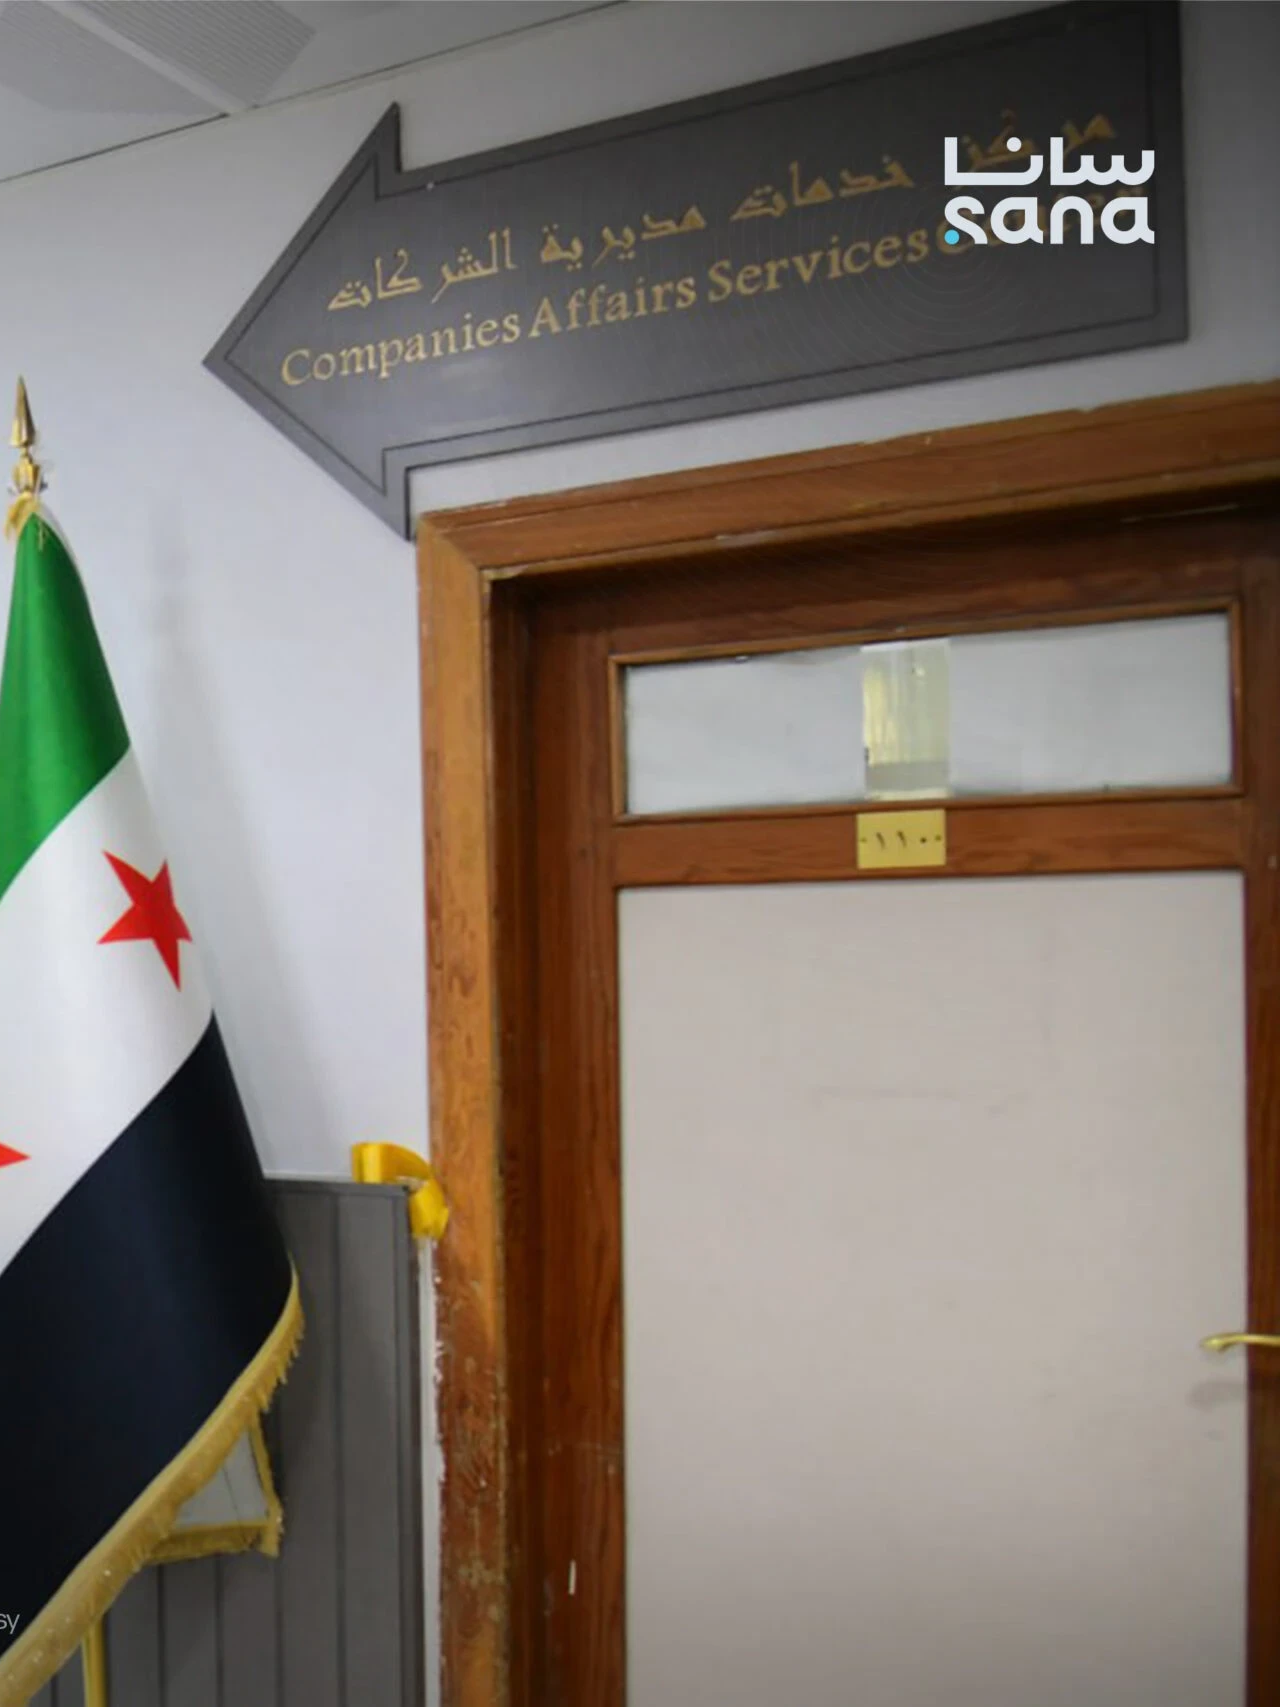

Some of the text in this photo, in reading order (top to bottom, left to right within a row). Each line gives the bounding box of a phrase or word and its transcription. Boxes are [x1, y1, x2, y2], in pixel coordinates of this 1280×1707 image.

[729, 154, 915, 222] خدمات
[327, 227, 518, 311] الشركات
[540, 203, 708, 269] مديرية
[280, 233, 930, 386] Companies Affairs Services
